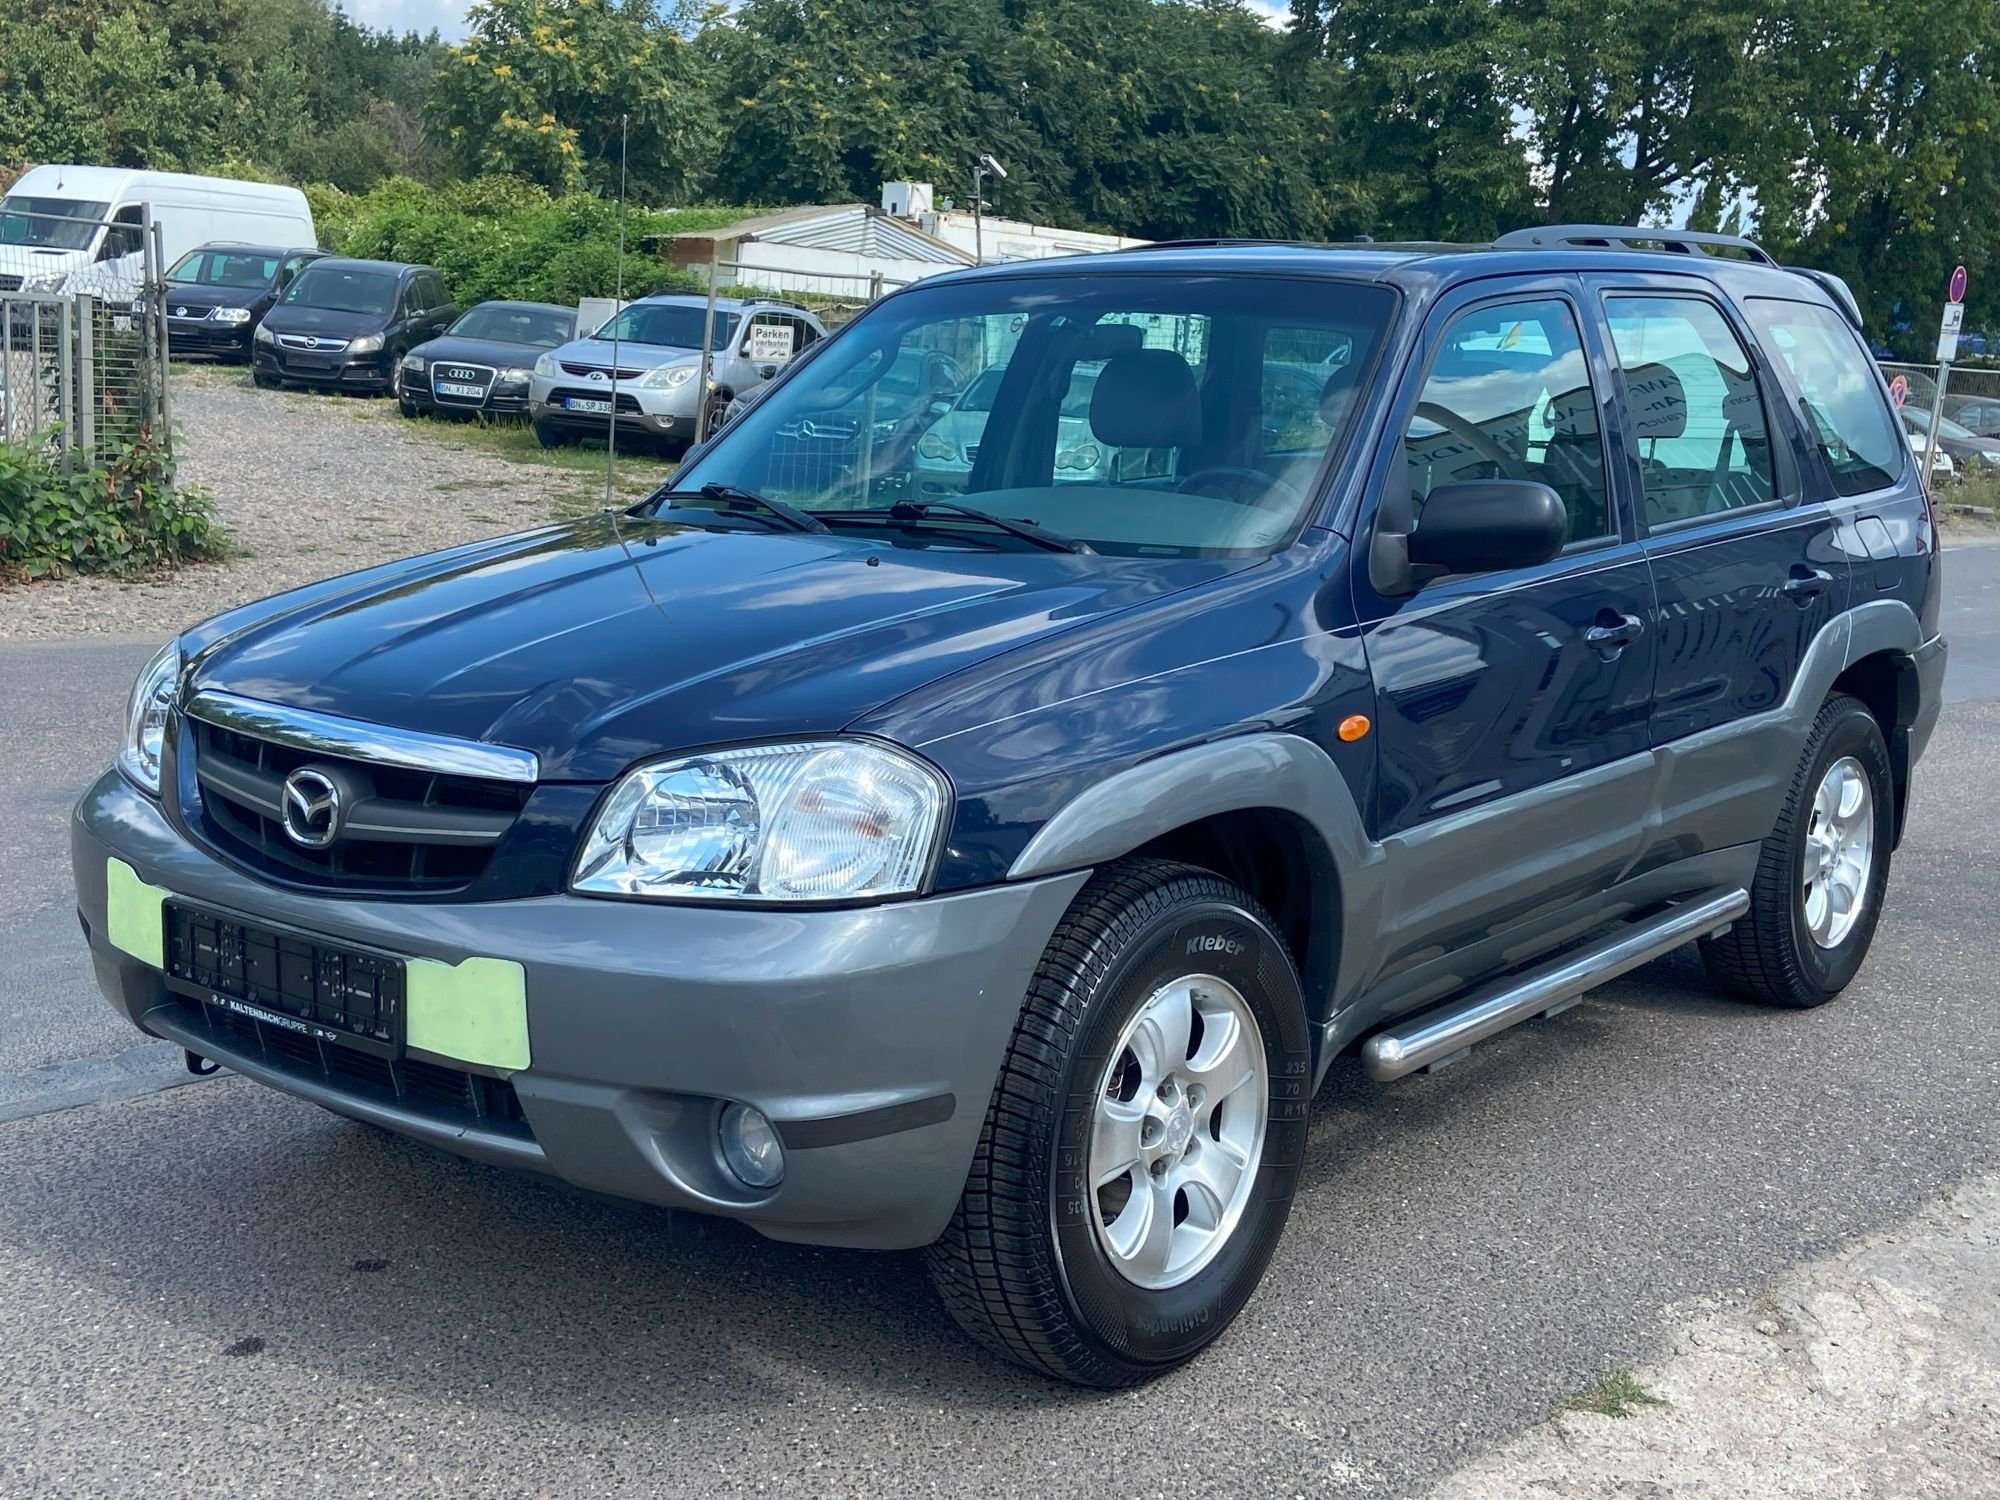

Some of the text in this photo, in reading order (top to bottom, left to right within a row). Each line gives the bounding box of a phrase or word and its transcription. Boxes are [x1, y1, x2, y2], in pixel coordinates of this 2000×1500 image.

[756, 328, 789, 338] Parken
[1185, 934, 1246, 955] Kleber
[1286, 1083, 1300, 1096] 70
